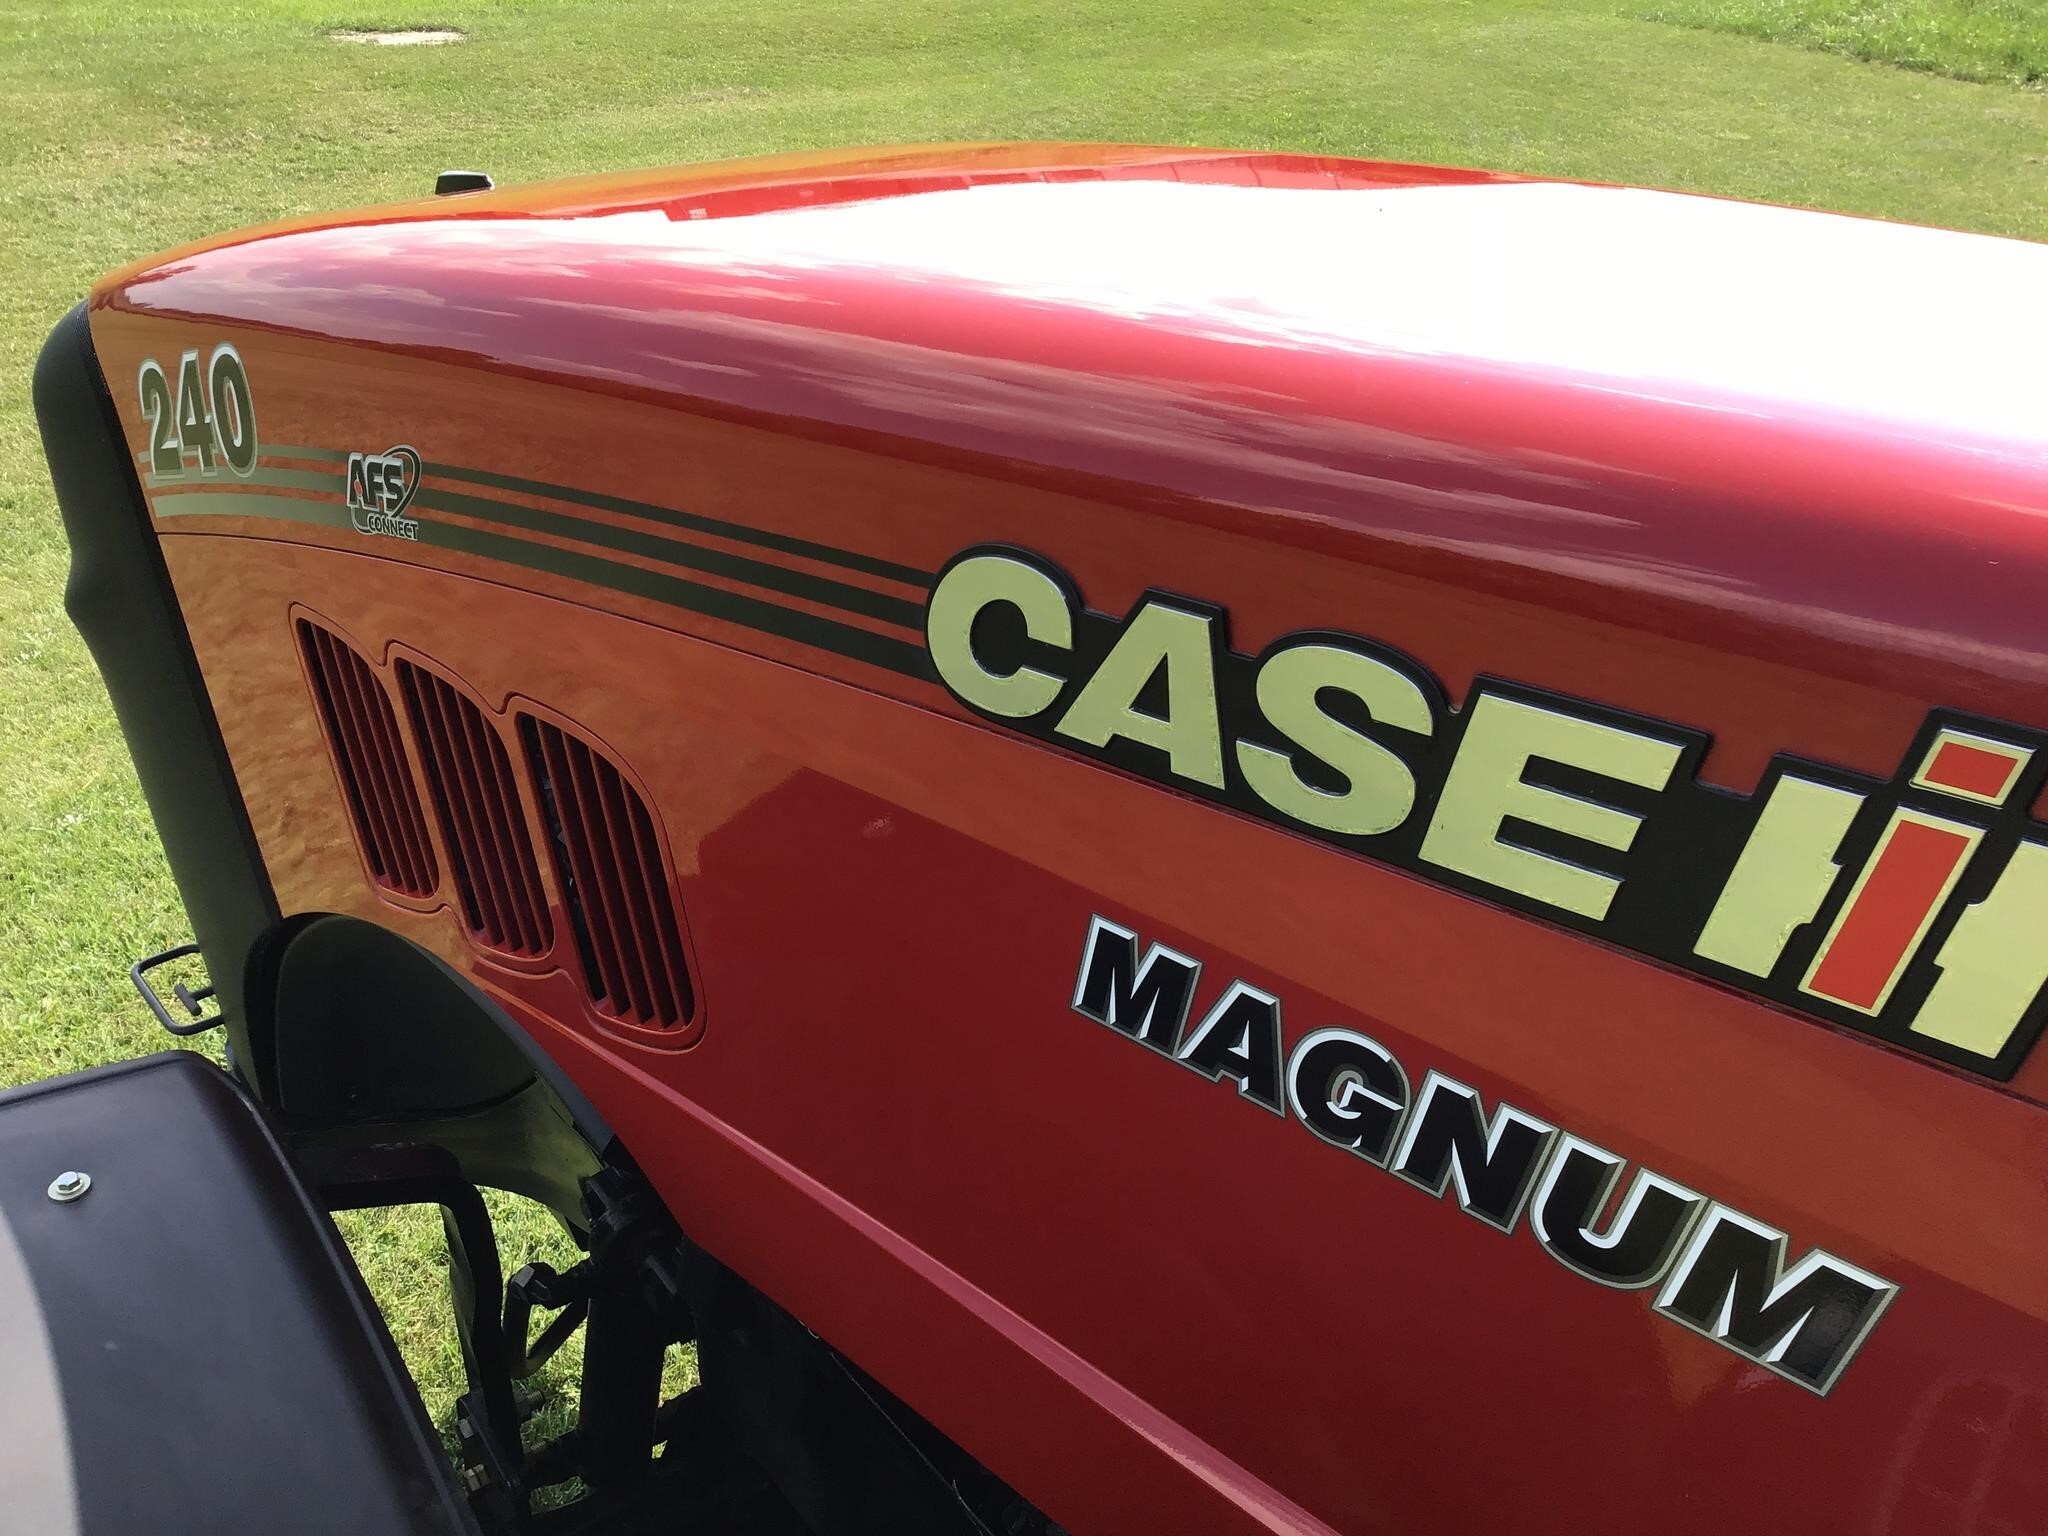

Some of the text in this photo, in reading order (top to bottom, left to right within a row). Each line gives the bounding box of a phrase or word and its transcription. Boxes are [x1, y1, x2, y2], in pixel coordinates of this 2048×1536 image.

[138, 341, 257, 479] 240
[347, 452, 405, 513] AFS
[367, 513, 419, 541] CONNECT
[926, 555, 1688, 921] CASE
[1071, 913, 1901, 1397] MAGNUM
